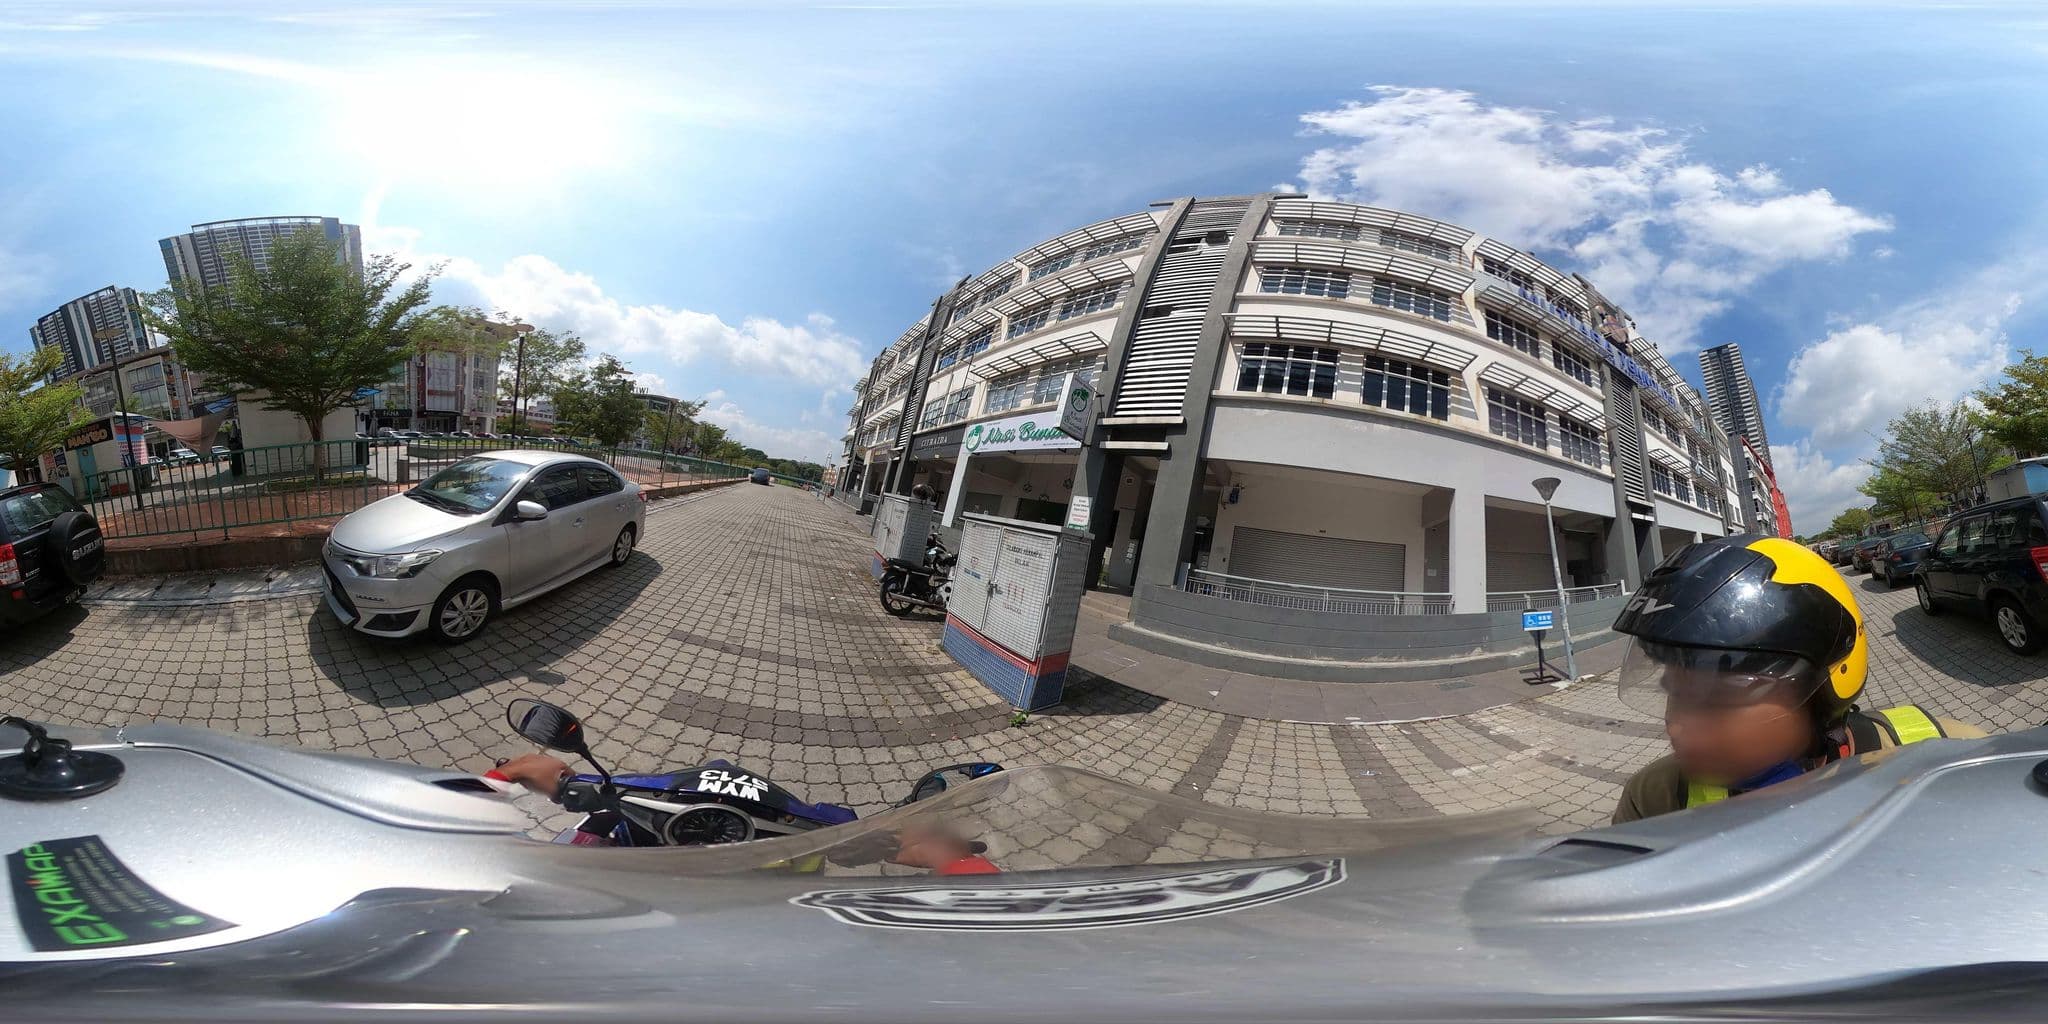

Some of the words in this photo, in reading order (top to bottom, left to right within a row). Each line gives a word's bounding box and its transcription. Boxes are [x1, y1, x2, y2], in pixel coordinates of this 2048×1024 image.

[982, 427, 1016, 445] Nasi
[72, 538, 102, 560] SUZU
[697, 779, 760, 801] WYM
[699, 770, 768, 792] 5713
